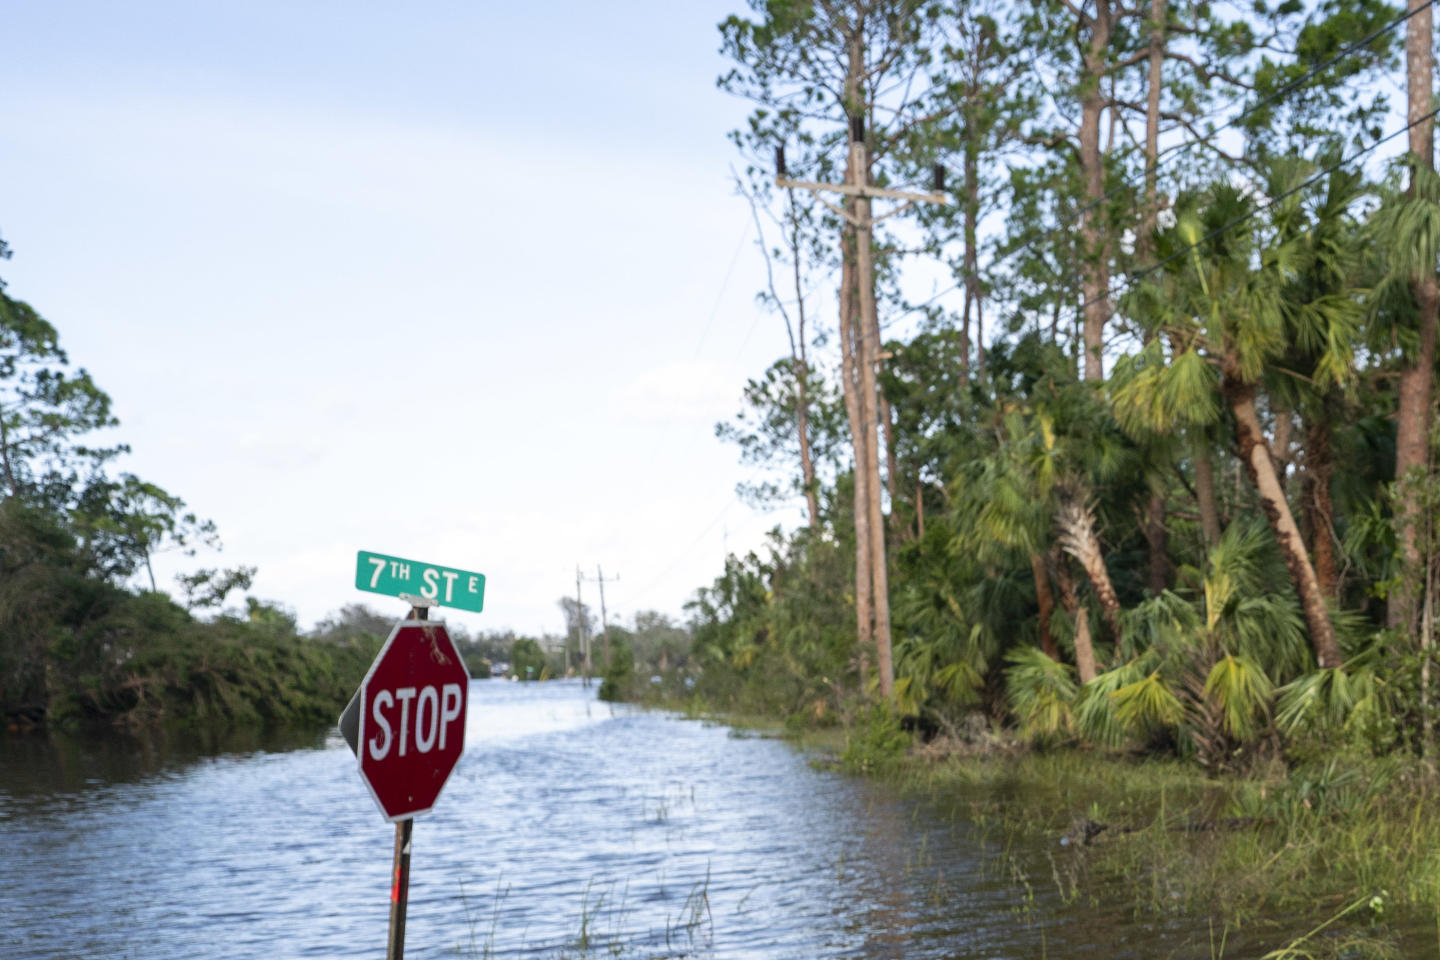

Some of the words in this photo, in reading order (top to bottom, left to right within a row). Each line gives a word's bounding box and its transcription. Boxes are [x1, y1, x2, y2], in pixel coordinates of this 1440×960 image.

[368, 557, 411, 588] 7TH
[420, 568, 459, 603] ST
[468, 575, 479, 594] E
[368, 682, 463, 762] STOP
